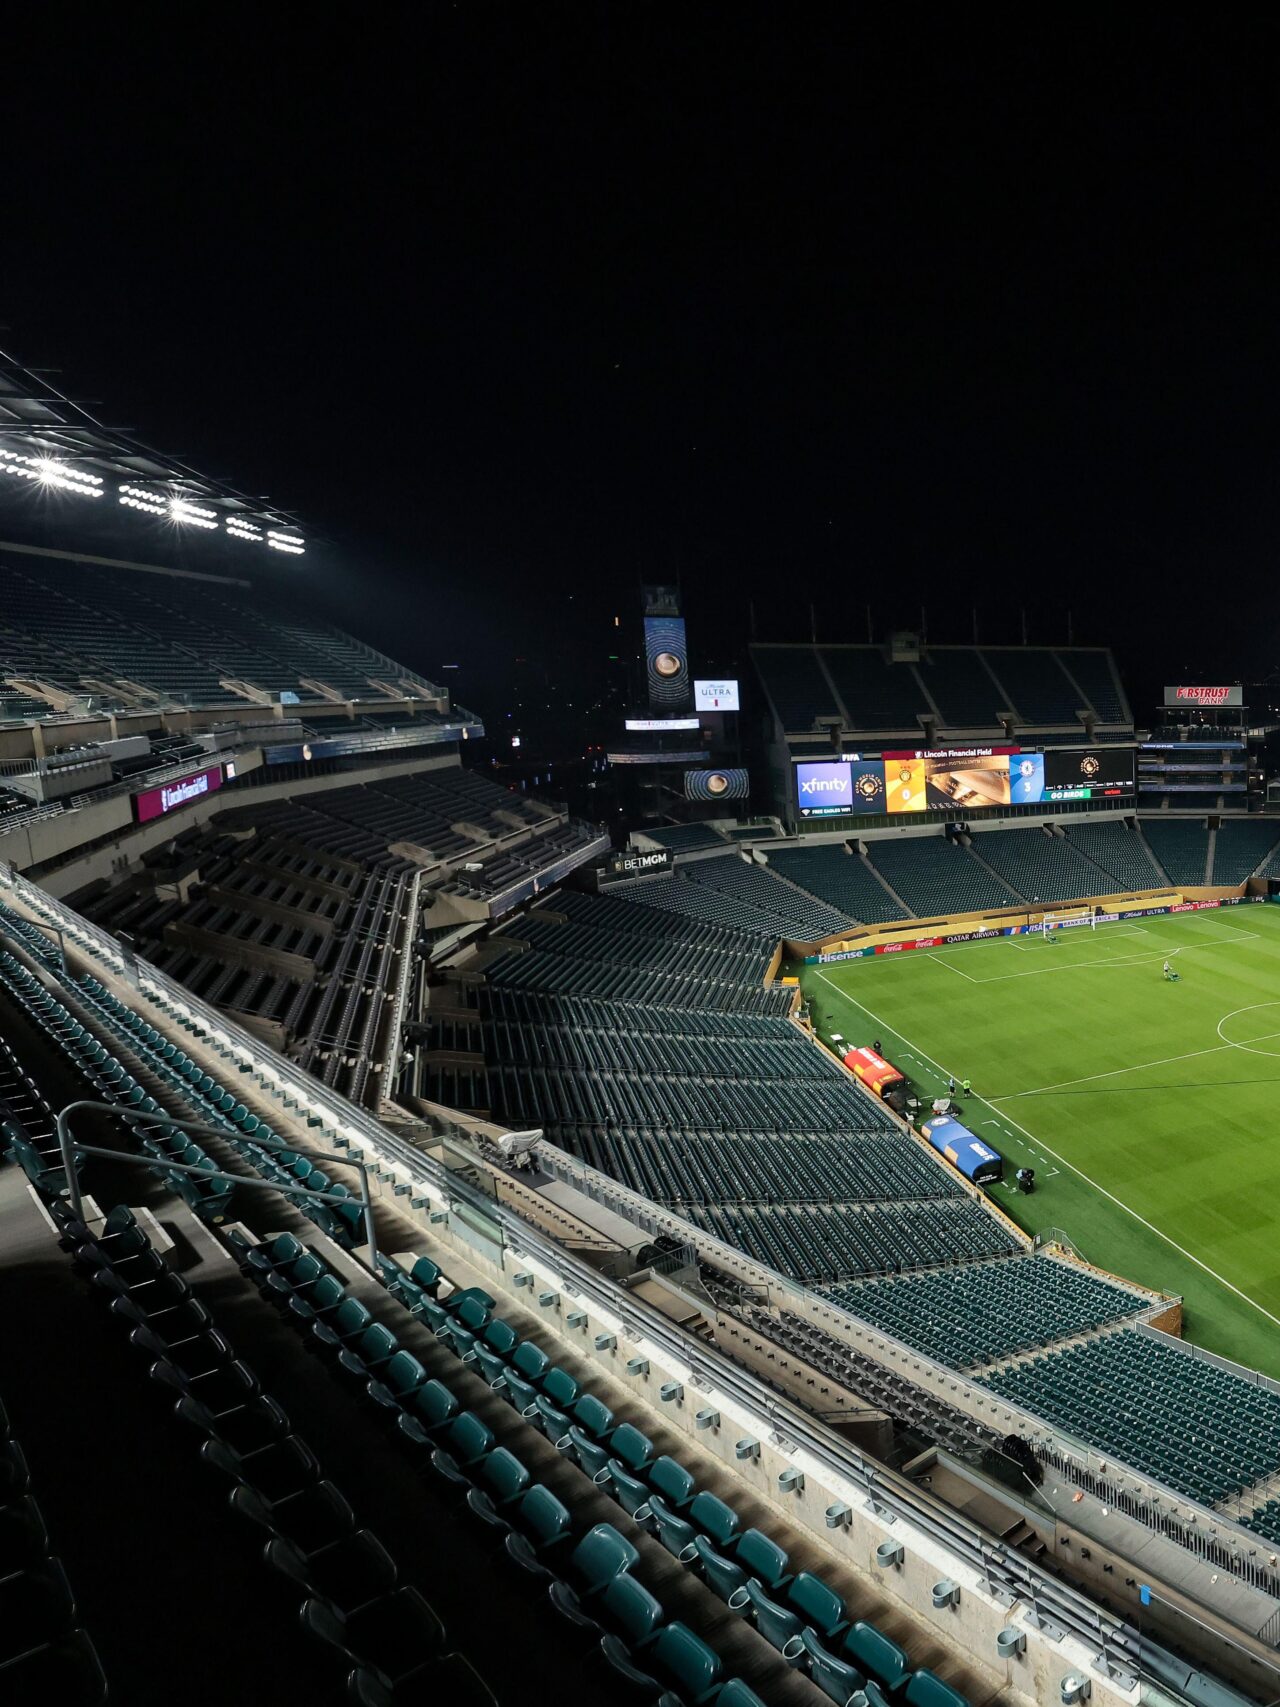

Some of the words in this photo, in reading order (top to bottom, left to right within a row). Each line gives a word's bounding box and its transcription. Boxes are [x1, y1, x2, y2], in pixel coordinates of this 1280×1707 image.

[1177, 688, 1230, 698] FIRSTRUST
[1198, 697, 1224, 705] BANK
[801, 778, 848, 794] xfinity
[1024, 782, 1031, 792] 3
[902, 789, 910, 800] 0
[624, 853, 667, 870] BETMGM
[947, 934, 970, 943] QATAR
[972, 930, 999, 939] AIRWAYS
[818, 950, 864, 964] Hisense
